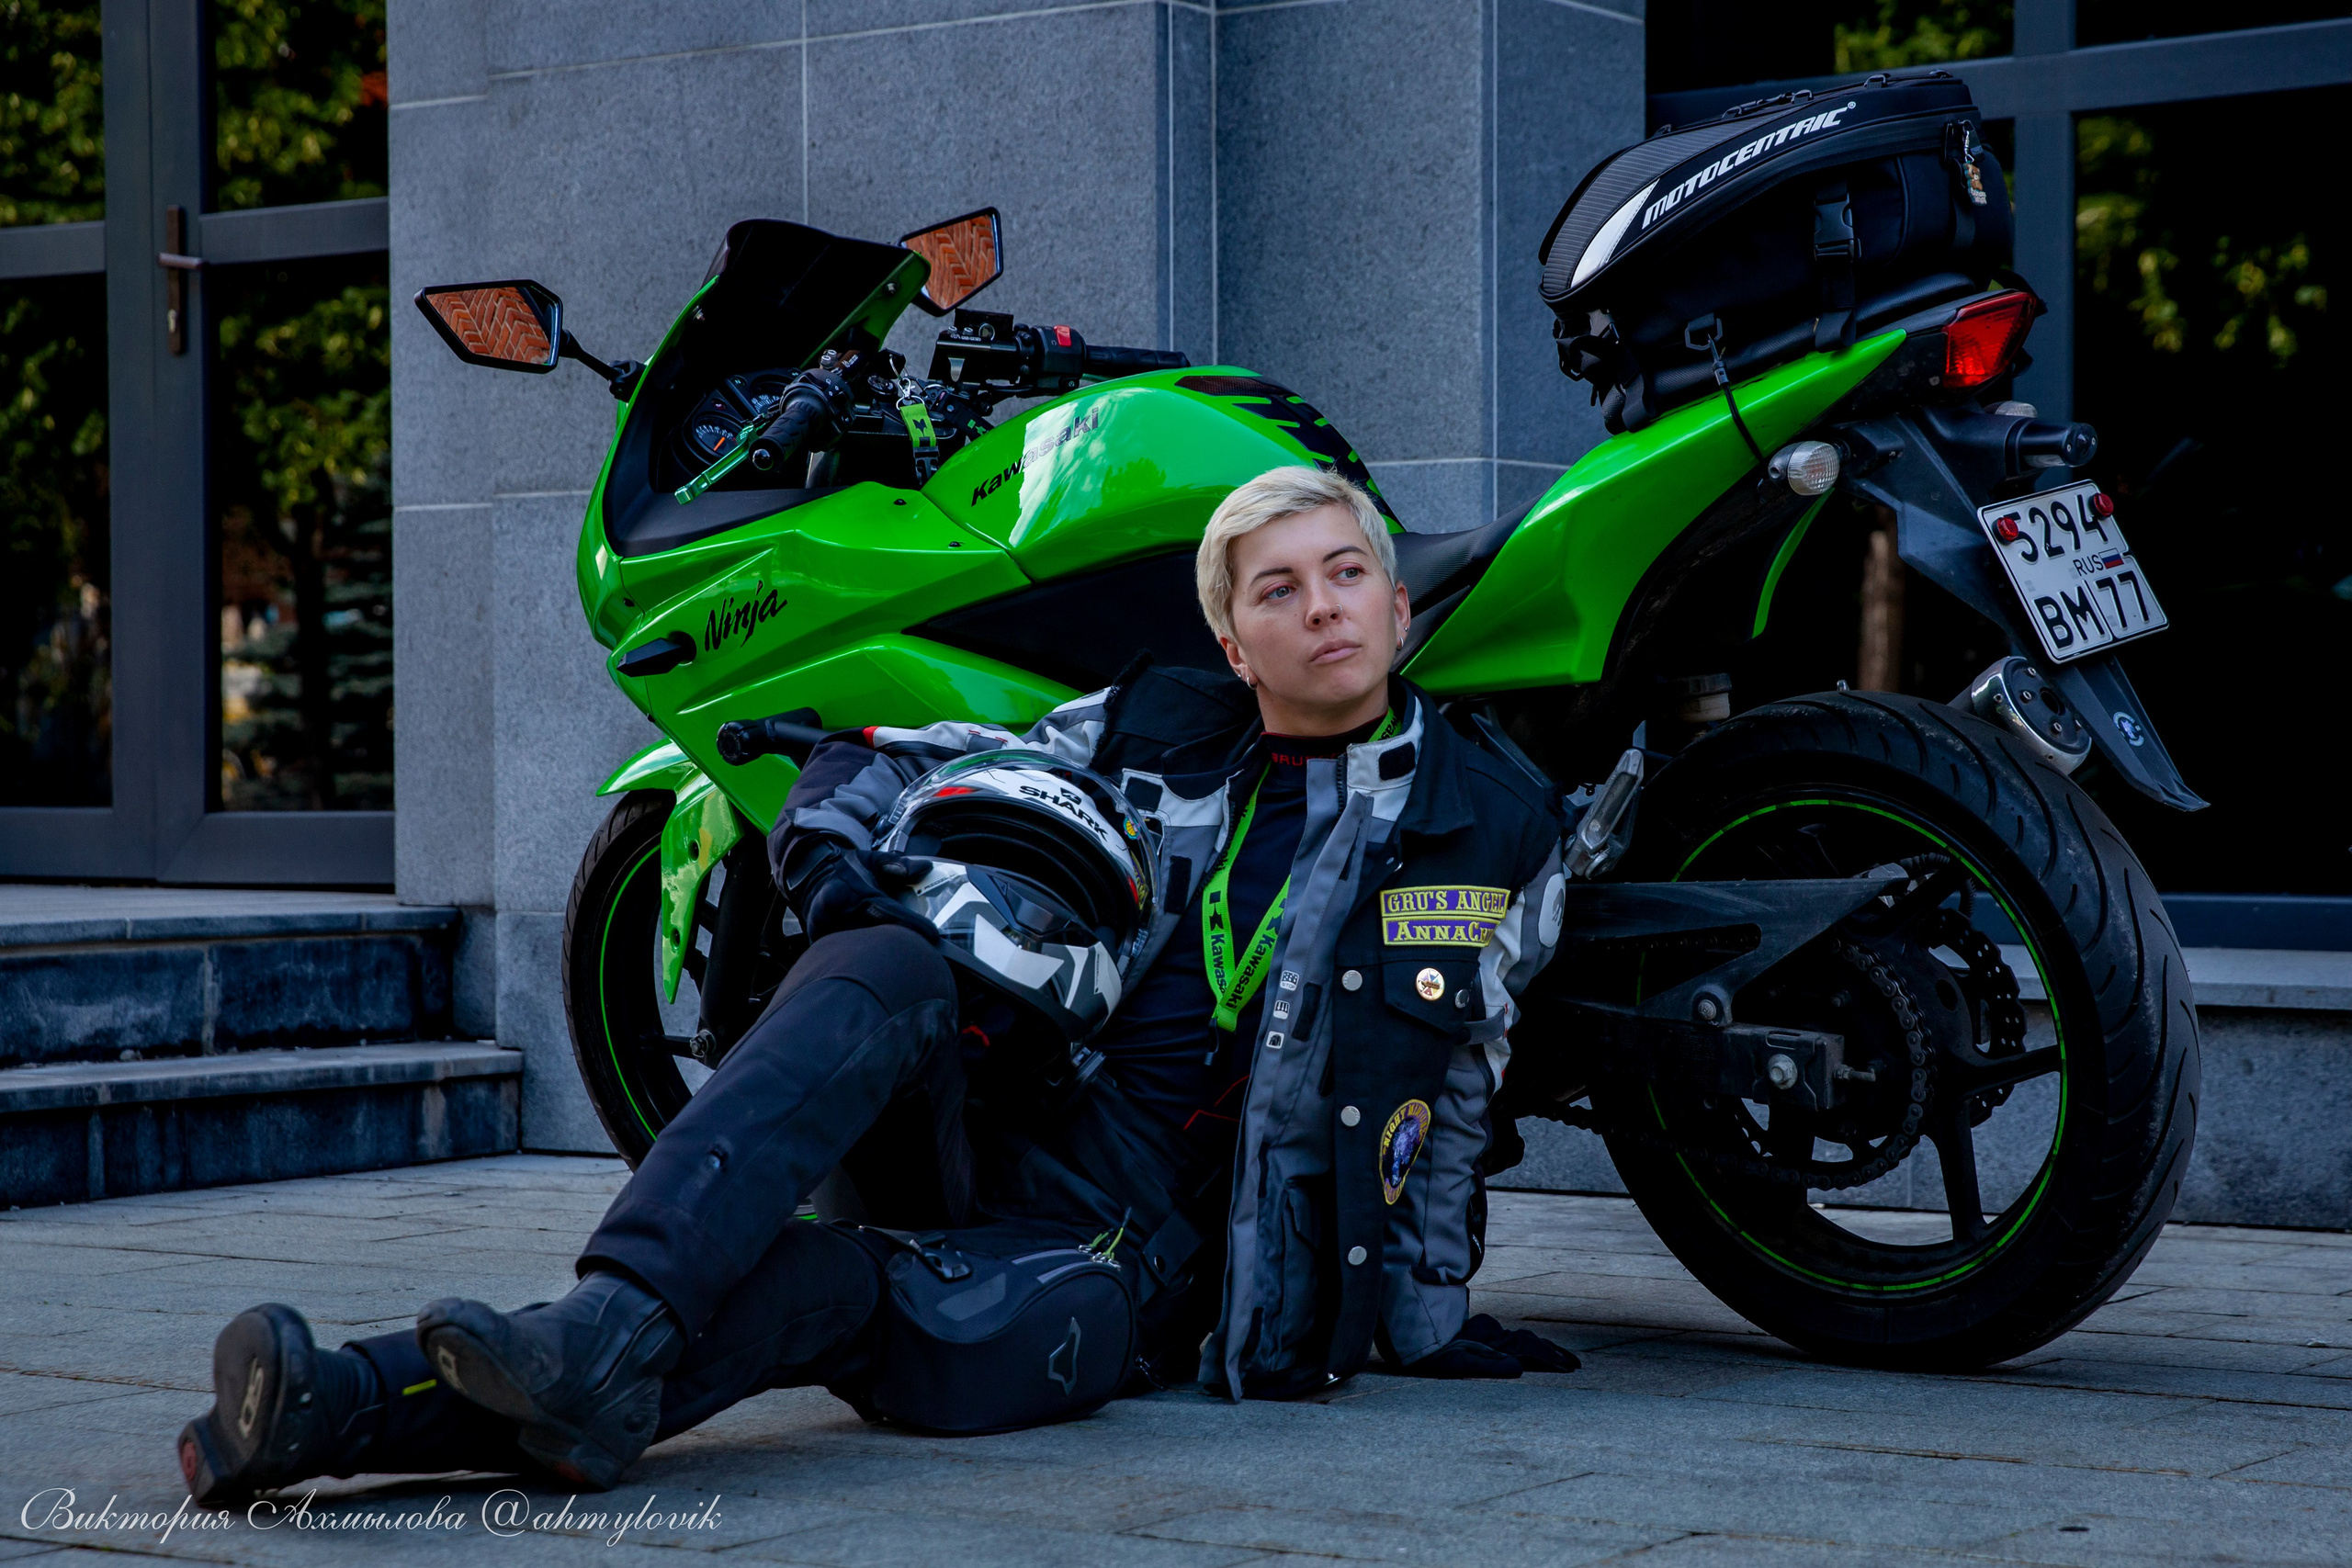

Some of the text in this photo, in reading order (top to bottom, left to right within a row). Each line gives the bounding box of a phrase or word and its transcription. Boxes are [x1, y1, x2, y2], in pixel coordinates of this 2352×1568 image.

[970, 407, 1101, 506] Kawasaki
[2002, 493, 2109, 564] 5294
[2073, 554, 2103, 577] RUS
[704, 580, 787, 652] Ninja
[2095, 570, 2149, 629] 77
[1019, 784, 1108, 841] SHARK
[1387, 890, 1505, 914] GRU'S ANGEL
[1226, 933, 1275, 1010] Kawasaki
